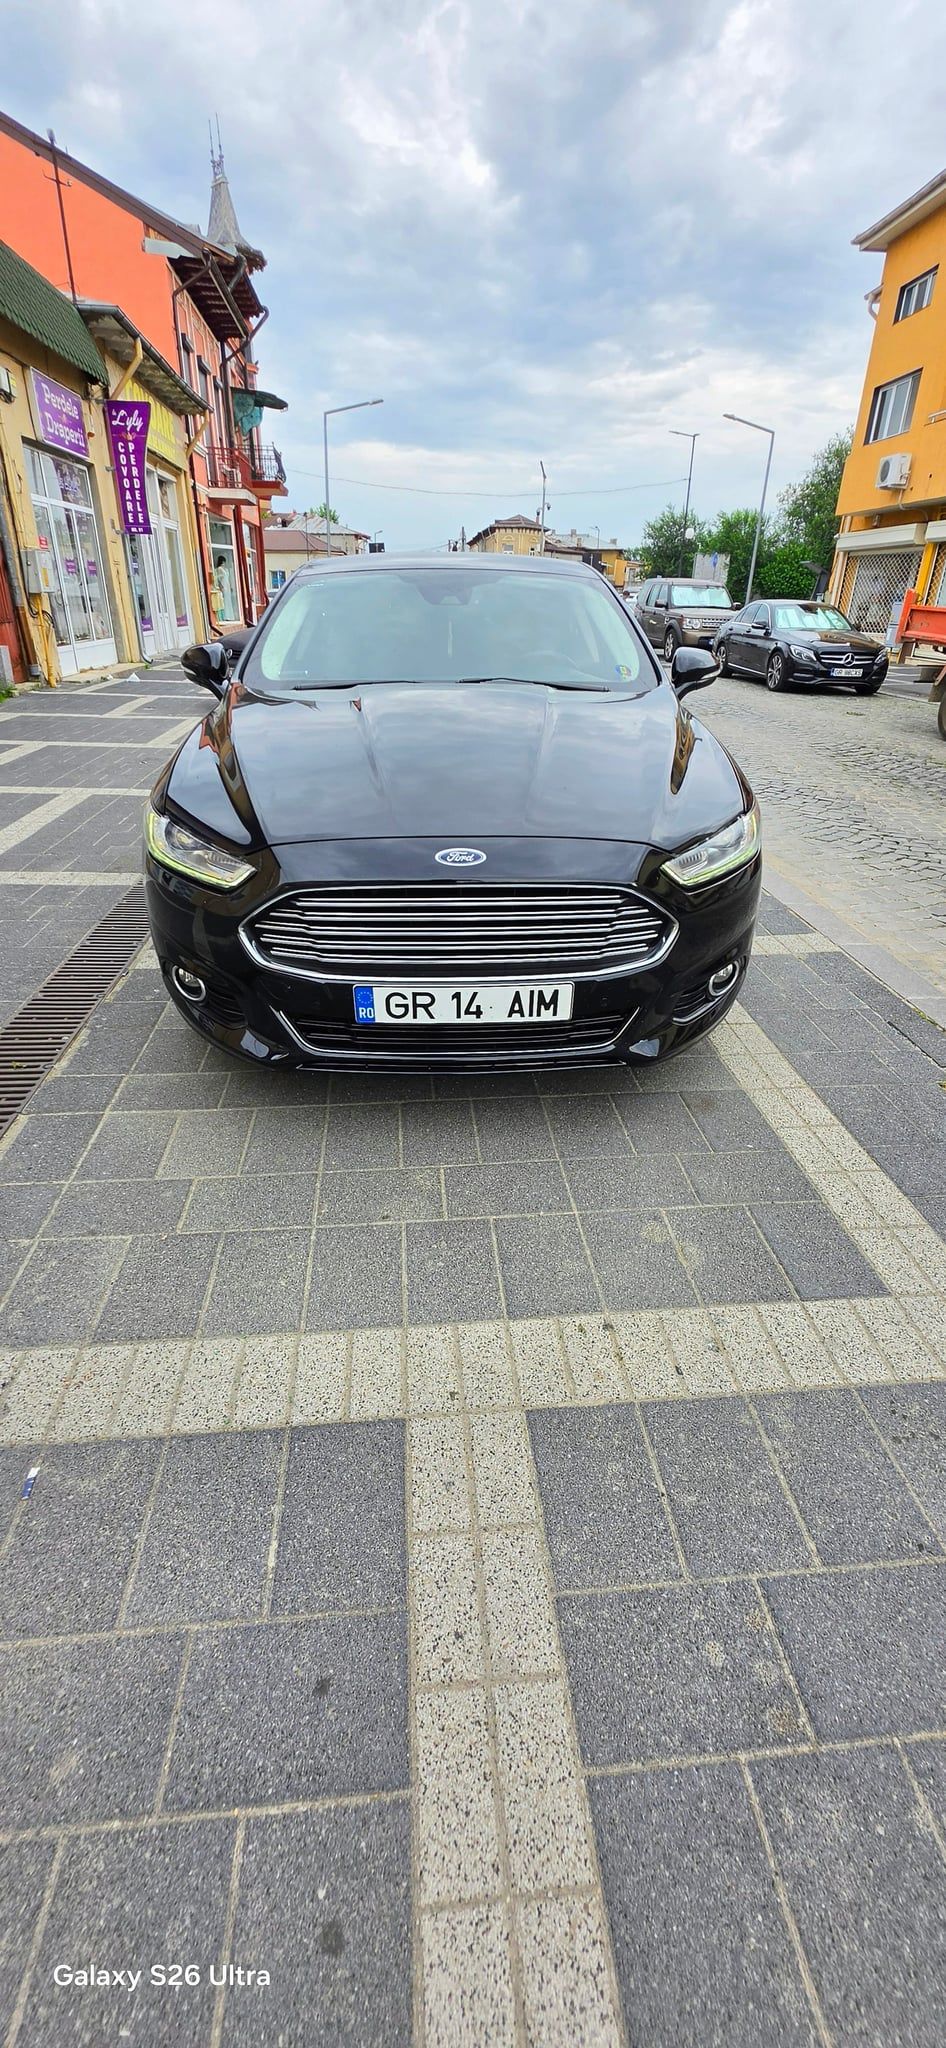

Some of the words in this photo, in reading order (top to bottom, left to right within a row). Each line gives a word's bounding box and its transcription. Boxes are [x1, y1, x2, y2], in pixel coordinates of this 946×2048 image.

[41, 382, 79, 420] Perdele
[45, 411, 85, 448] Draperii
[112, 409, 144, 432] Lyly
[118, 442, 134, 523] COVOARE
[128, 442, 144, 523] PERDELE
[446, 851, 475, 862] Ford
[359, 1007, 374, 1019] RO
[385, 991, 436, 1020] GR
[451, 991, 483, 1019] 14
[507, 989, 559, 1018] AIM
